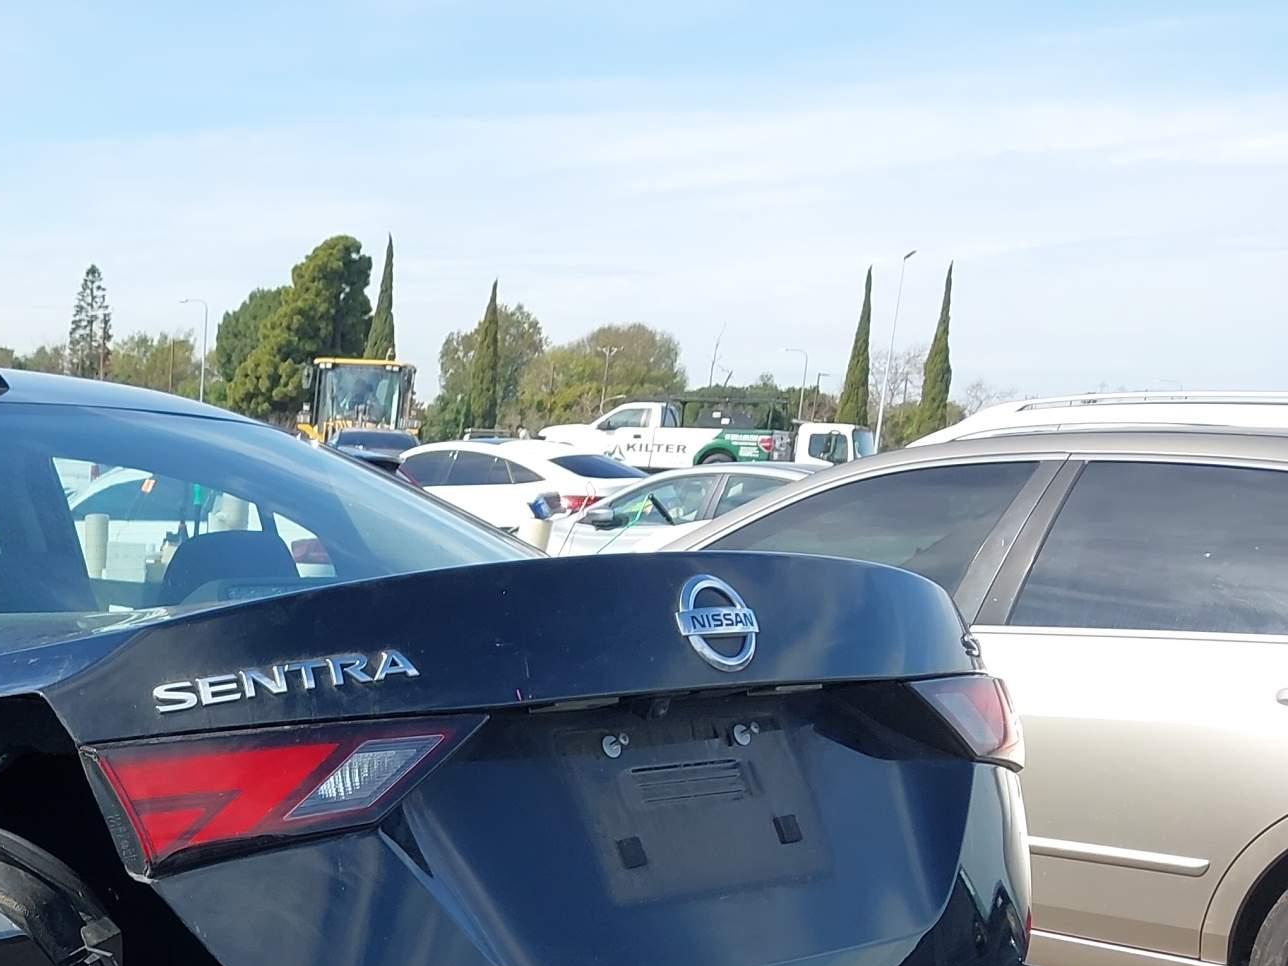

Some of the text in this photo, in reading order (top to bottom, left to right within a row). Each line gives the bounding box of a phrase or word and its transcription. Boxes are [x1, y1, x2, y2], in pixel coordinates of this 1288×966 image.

[626, 443, 687, 454] KILTER
[691, 612, 754, 629] NISSAN
[152, 649, 421, 714] SENTRA
